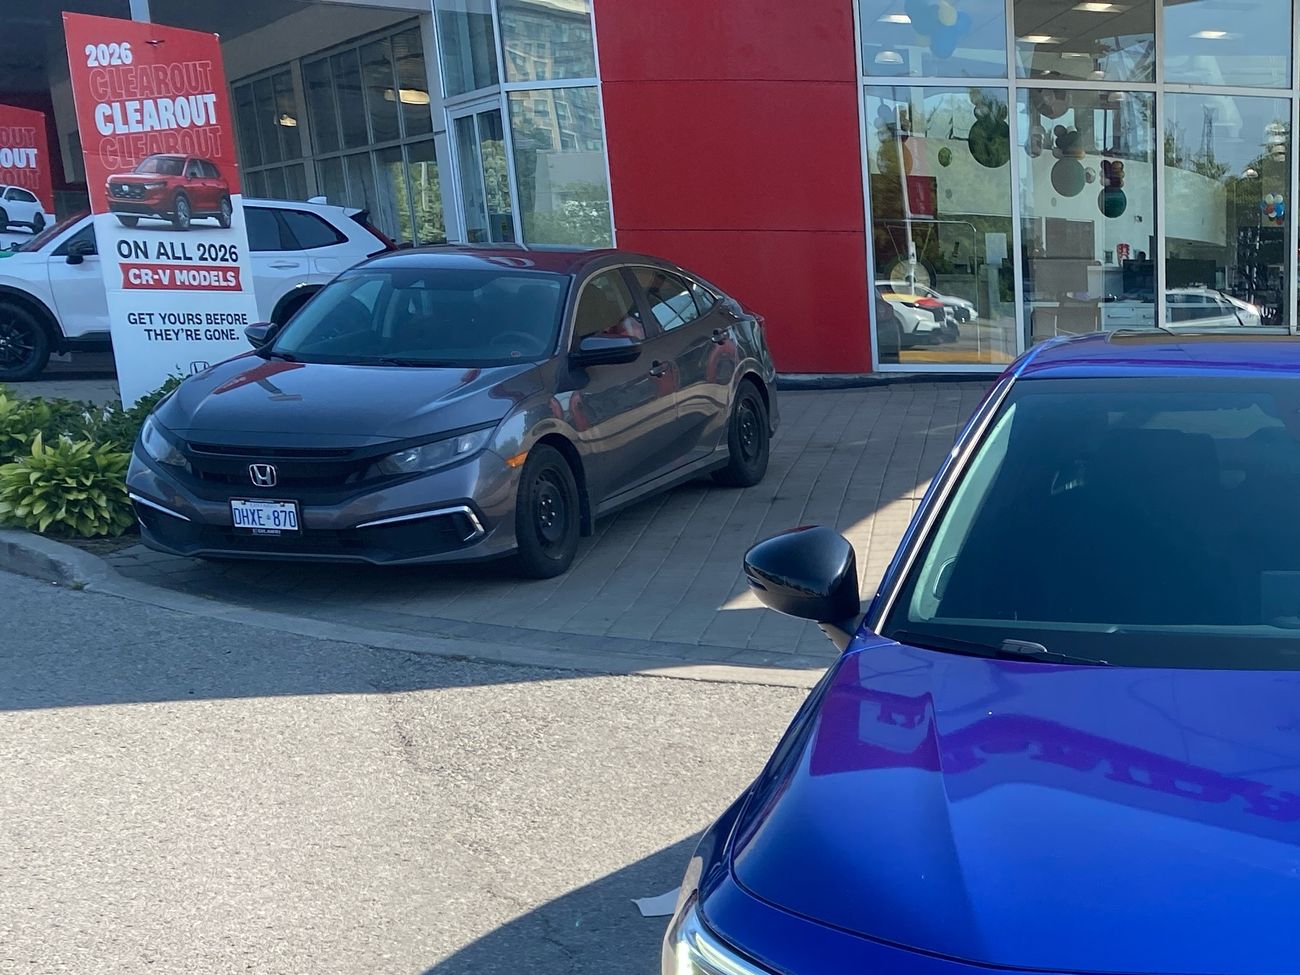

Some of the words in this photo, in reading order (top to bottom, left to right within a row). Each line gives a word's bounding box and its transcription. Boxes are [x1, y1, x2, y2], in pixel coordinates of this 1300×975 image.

[85, 42, 133, 67] 2026
[89, 61, 212, 101] CLEAROUT
[94, 93, 217, 136] CLEAROUT
[100, 126, 222, 170] CLEAROUT
[117, 239, 149, 259] ON
[156, 241, 193, 261] ALL
[197, 243, 239, 263] 2026
[128, 268, 171, 286] CR-V
[174, 270, 236, 287] MODELS
[127, 313, 155, 325] GET
[158, 313, 203, 325] YOURS
[205, 313, 249, 325] BEFORE
[144, 328, 201, 341] THEY'RE
[204, 328, 240, 341] GONE.
[233, 508, 265, 526] DHXE
[272, 510, 296, 527] 870
